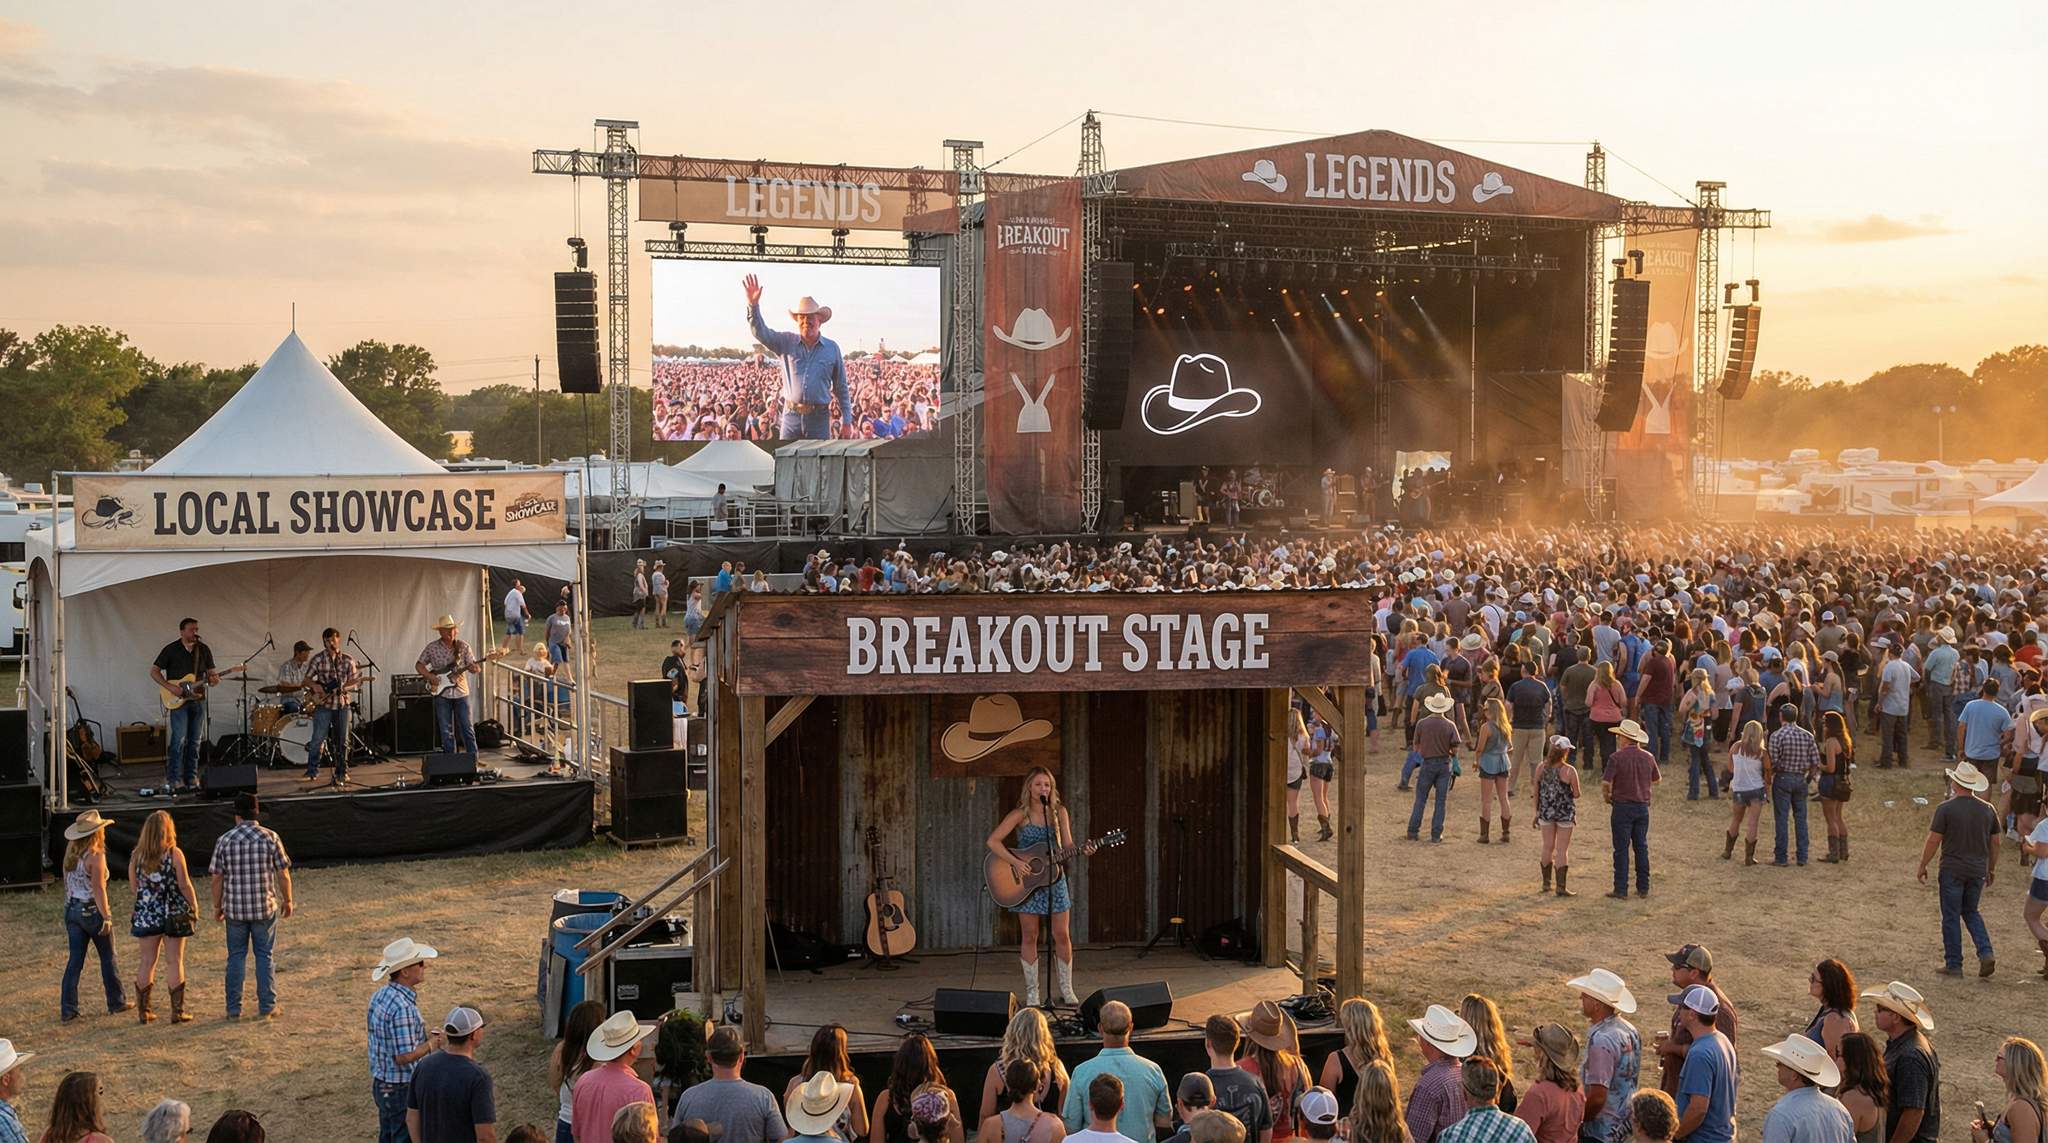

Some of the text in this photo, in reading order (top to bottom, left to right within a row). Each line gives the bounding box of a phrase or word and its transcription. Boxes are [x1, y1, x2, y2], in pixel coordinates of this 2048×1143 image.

[725, 175, 882, 223] LEGENDS
[1304, 152, 1456, 204] LEGENDS
[153, 488, 496, 536] LOCAL SHOWCASE
[846, 612, 1270, 675] BREAKOUT STAGE
